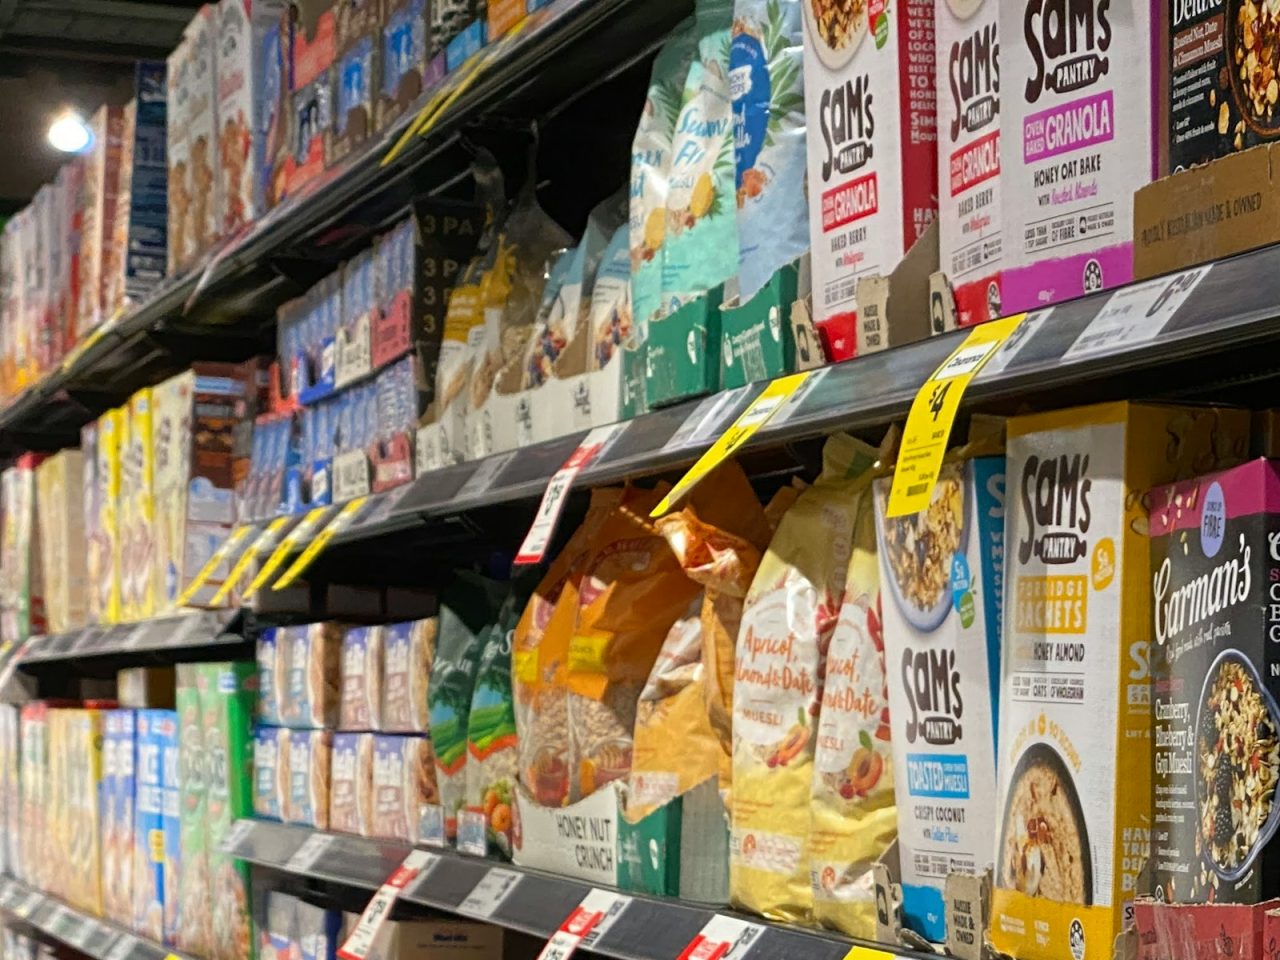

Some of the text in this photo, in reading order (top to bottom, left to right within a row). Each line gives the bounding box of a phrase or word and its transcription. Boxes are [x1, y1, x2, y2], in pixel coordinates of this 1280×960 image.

[1056, 59, 1096, 87] PANTRY
[1046, 108, 1110, 150] GRANOLA
[1034, 155, 1100, 187] HONEY OAT BAKE
[1042, 536, 1076, 560] PANTRY
[1153, 532, 1252, 647] Carman's
[1055, 642, 1085, 662] ALMOND
[925, 721, 952, 741] PANTRY
[557, 816, 611, 839] HONEY NUT
[935, 807, 965, 823] COCONUT
[576, 845, 613, 872] CRUNCH
